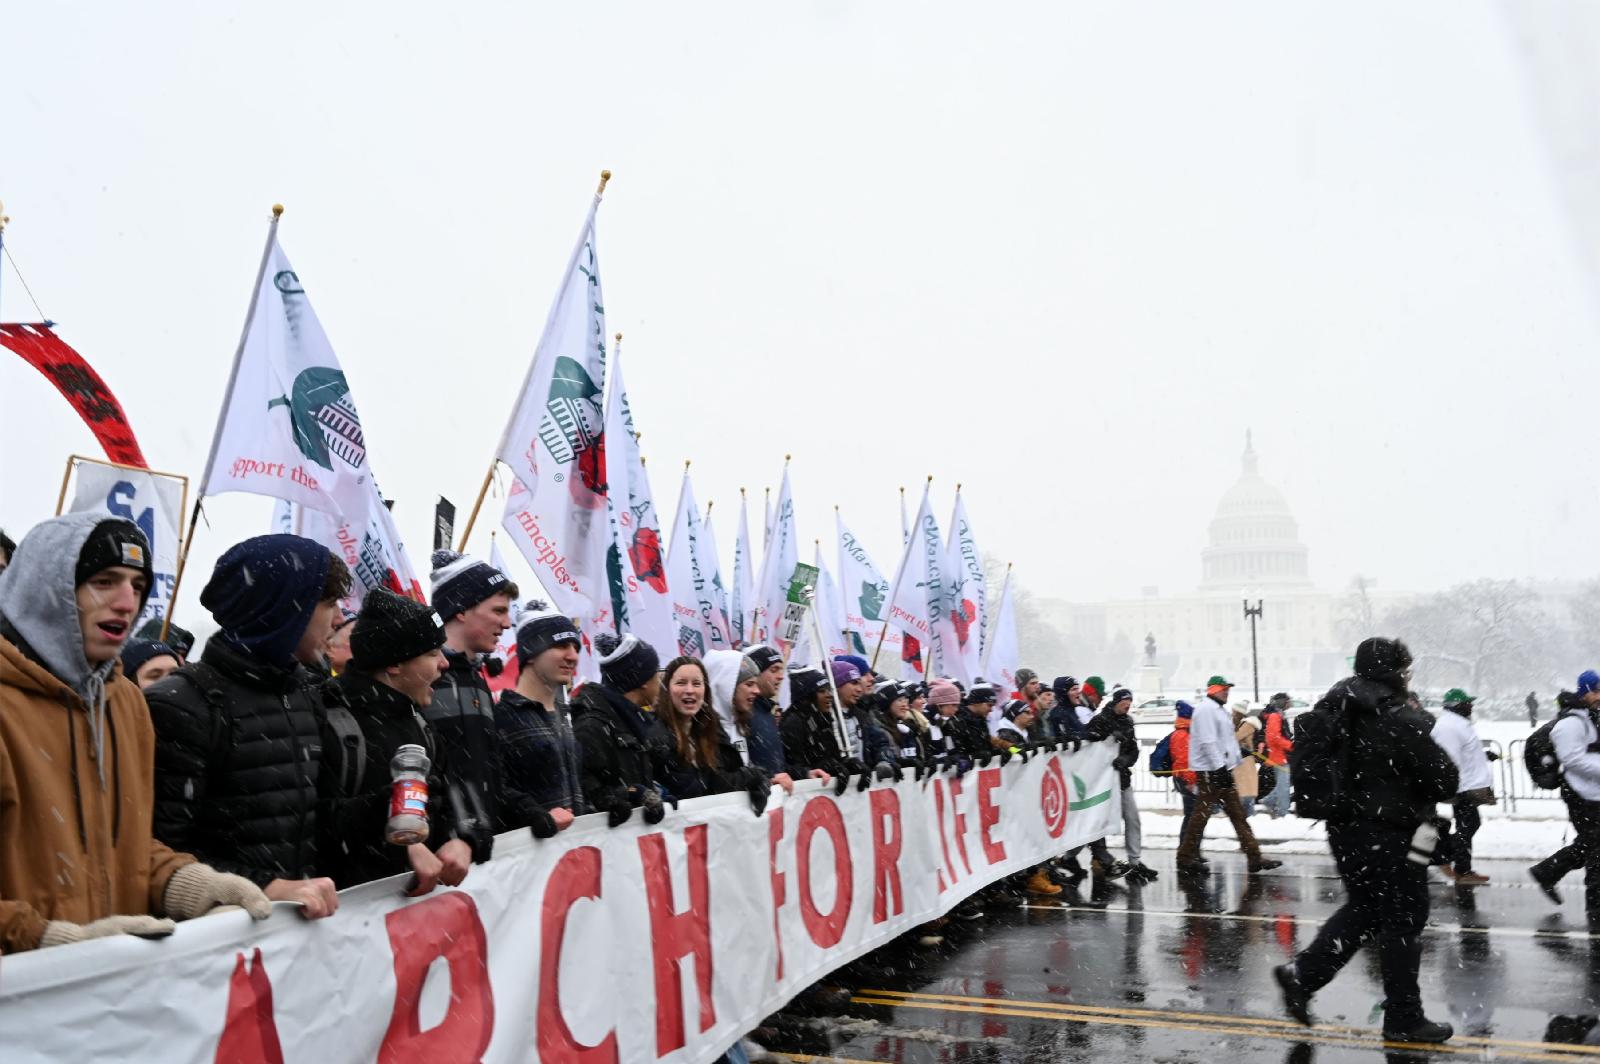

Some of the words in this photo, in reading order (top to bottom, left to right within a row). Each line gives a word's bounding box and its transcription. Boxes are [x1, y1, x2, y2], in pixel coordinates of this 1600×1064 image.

[230, 457, 285, 479] pport
[291, 463, 319, 491] the
[516, 511, 579, 593] rinciples”
[959, 519, 984, 582] March
[767, 788, 904, 982] FOR
[936, 768, 1008, 895] IFE
